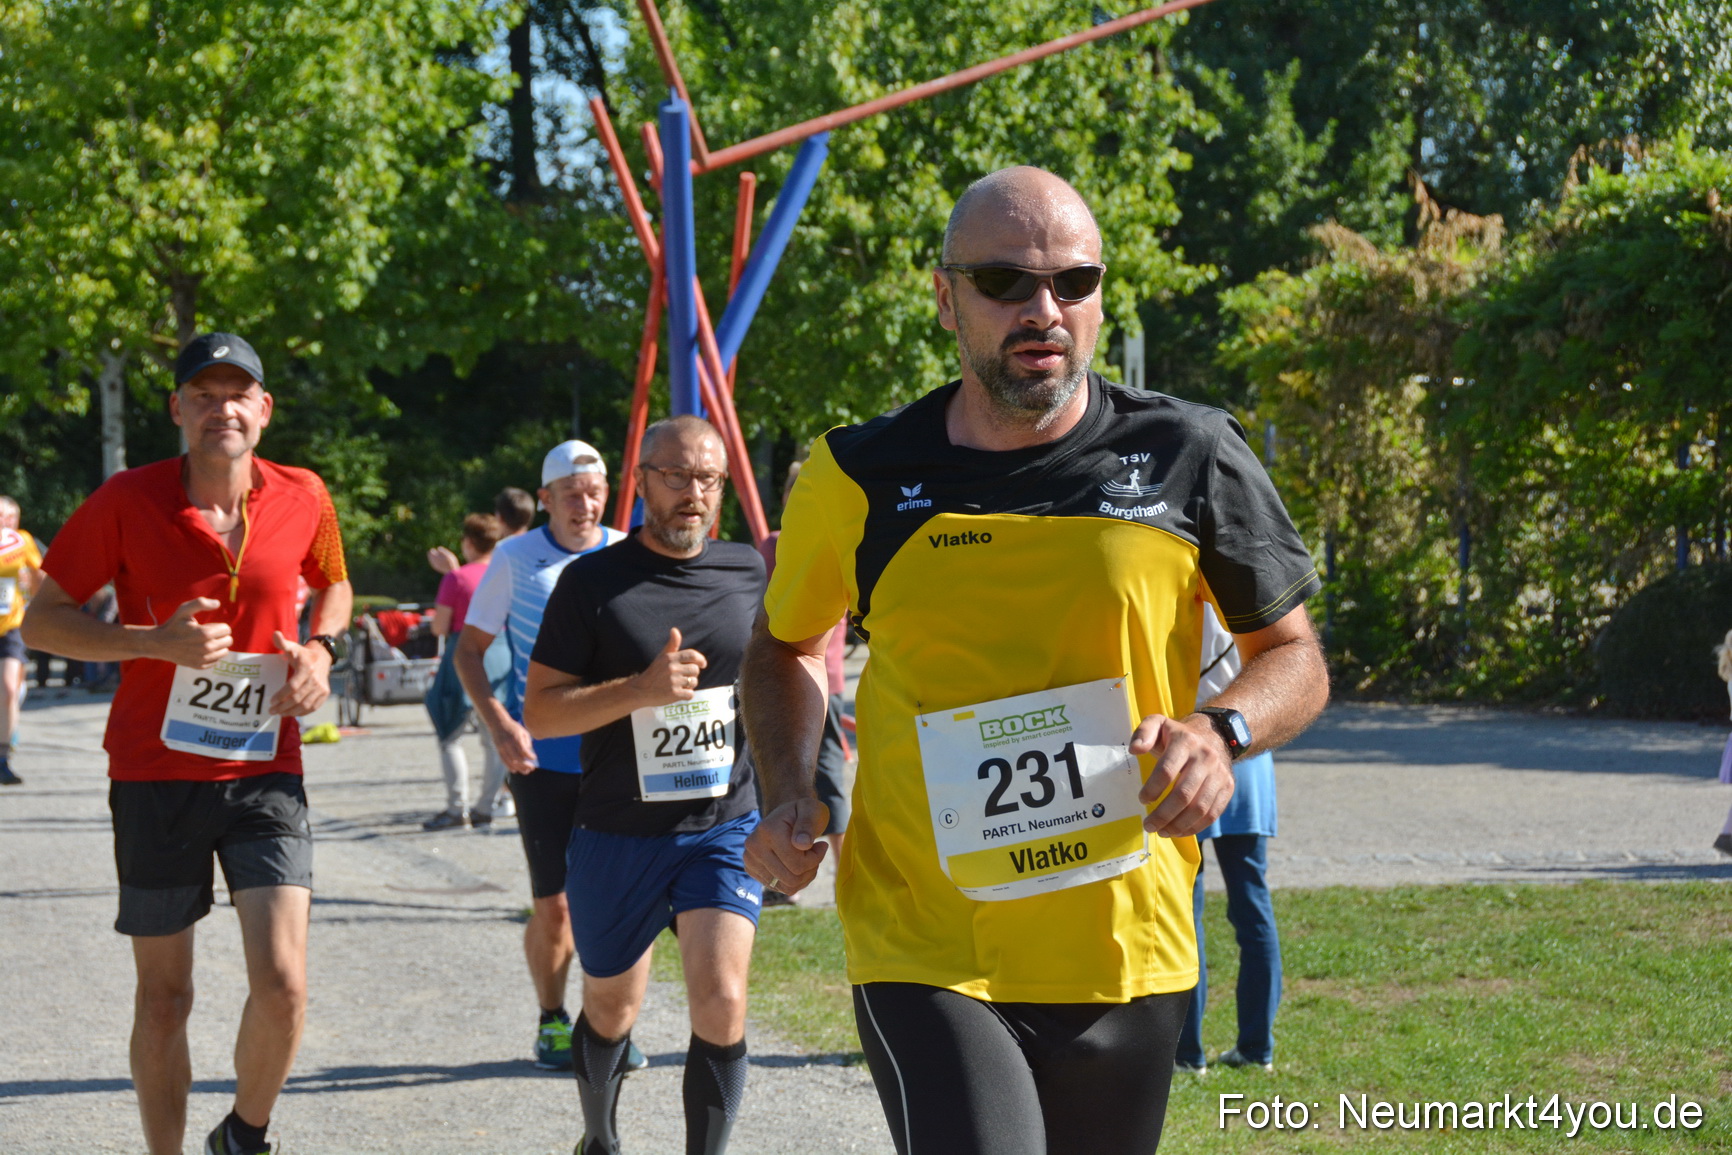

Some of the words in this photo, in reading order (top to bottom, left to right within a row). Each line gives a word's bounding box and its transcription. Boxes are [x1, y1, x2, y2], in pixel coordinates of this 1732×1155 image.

[1119, 452, 1151, 466] TSV
[896, 497, 933, 512] erima
[1098, 499, 1169, 520] Burgthann
[928, 530, 993, 549] Vlatko
[188, 677, 266, 715] 2241
[664, 700, 711, 718] BOCK
[979, 704, 1071, 742] BOCK
[199, 731, 247, 749] Jürgen
[652, 719, 726, 758] 2240
[983, 738, 1010, 749] inspired
[1011, 736, 1020, 745] by
[1021, 731, 1042, 742] smart
[1043, 725, 1073, 739] concepts
[662, 761, 686, 769] PARTL
[674, 771, 720, 789] Helmut
[977, 741, 1084, 818] 231
[944, 813, 953, 825] C
[982, 823, 1026, 841] PARTL
[1028, 809, 1088, 832] Neumarkt
[1009, 841, 1088, 875] Vlatko
